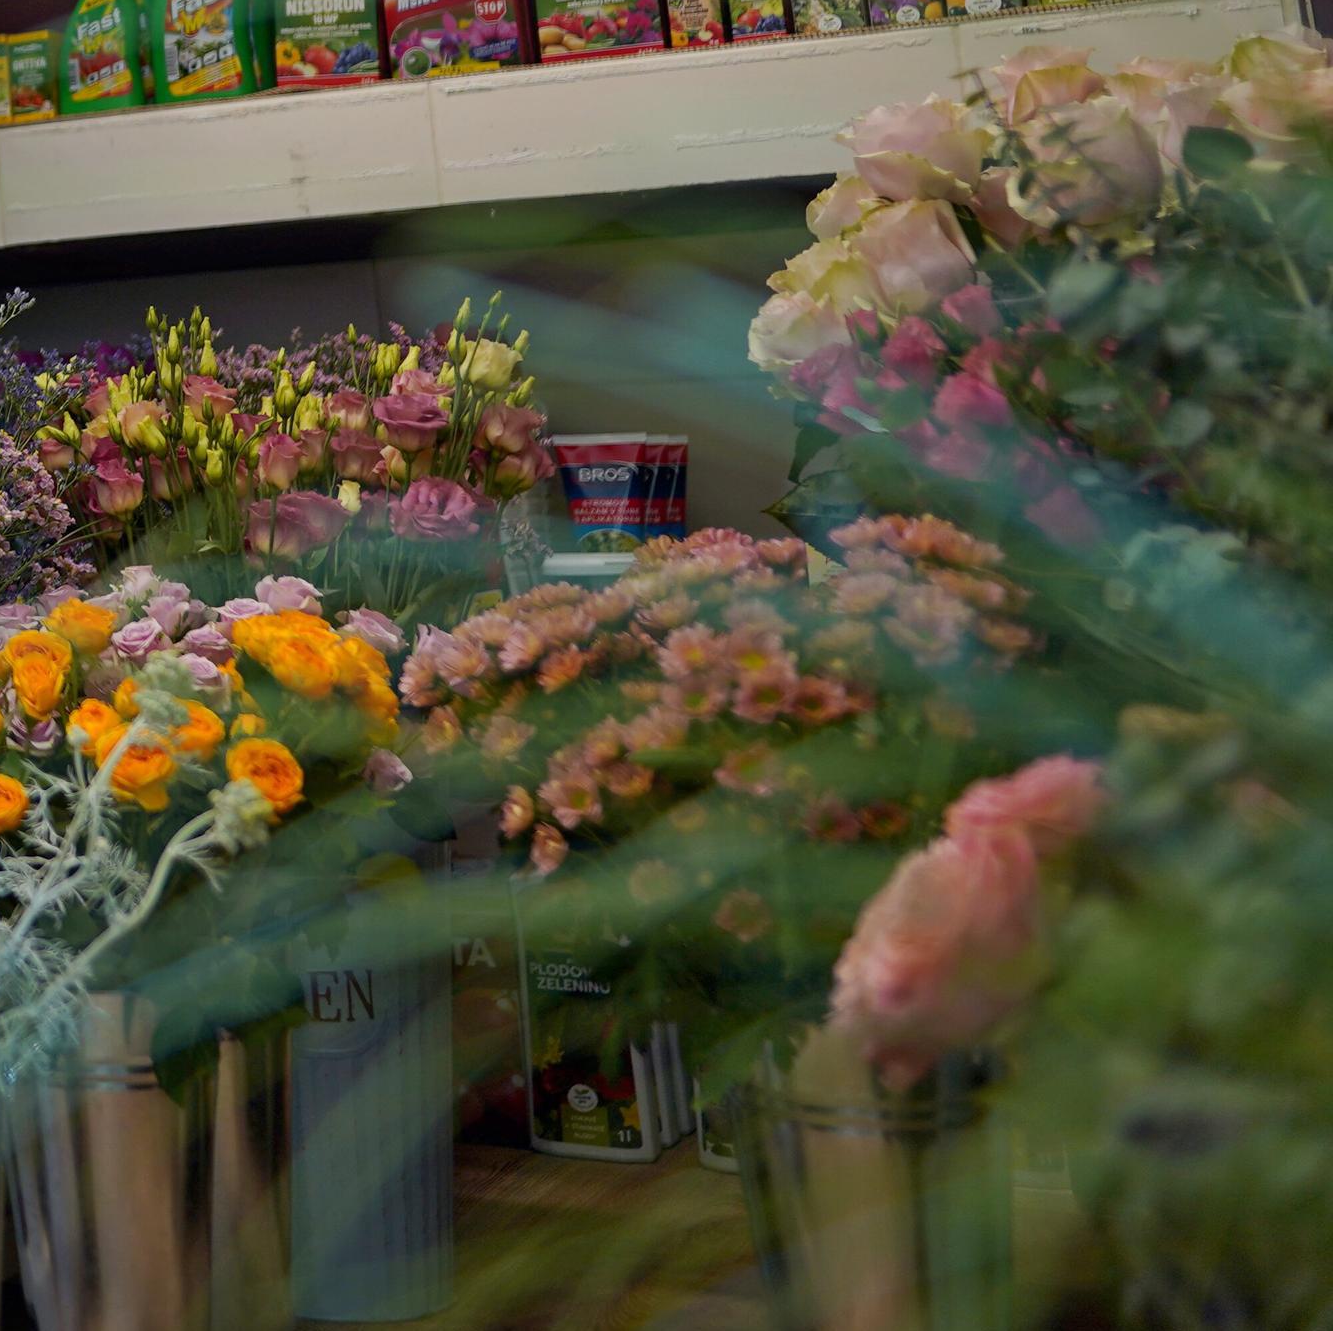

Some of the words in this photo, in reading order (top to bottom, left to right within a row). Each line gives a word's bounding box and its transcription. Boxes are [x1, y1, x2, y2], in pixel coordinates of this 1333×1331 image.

[477, 0, 504, 15] STOP
[77, 7, 121, 41] Fast
[578, 467, 631, 482] BROS
[536, 976, 611, 995] ZELENINU
